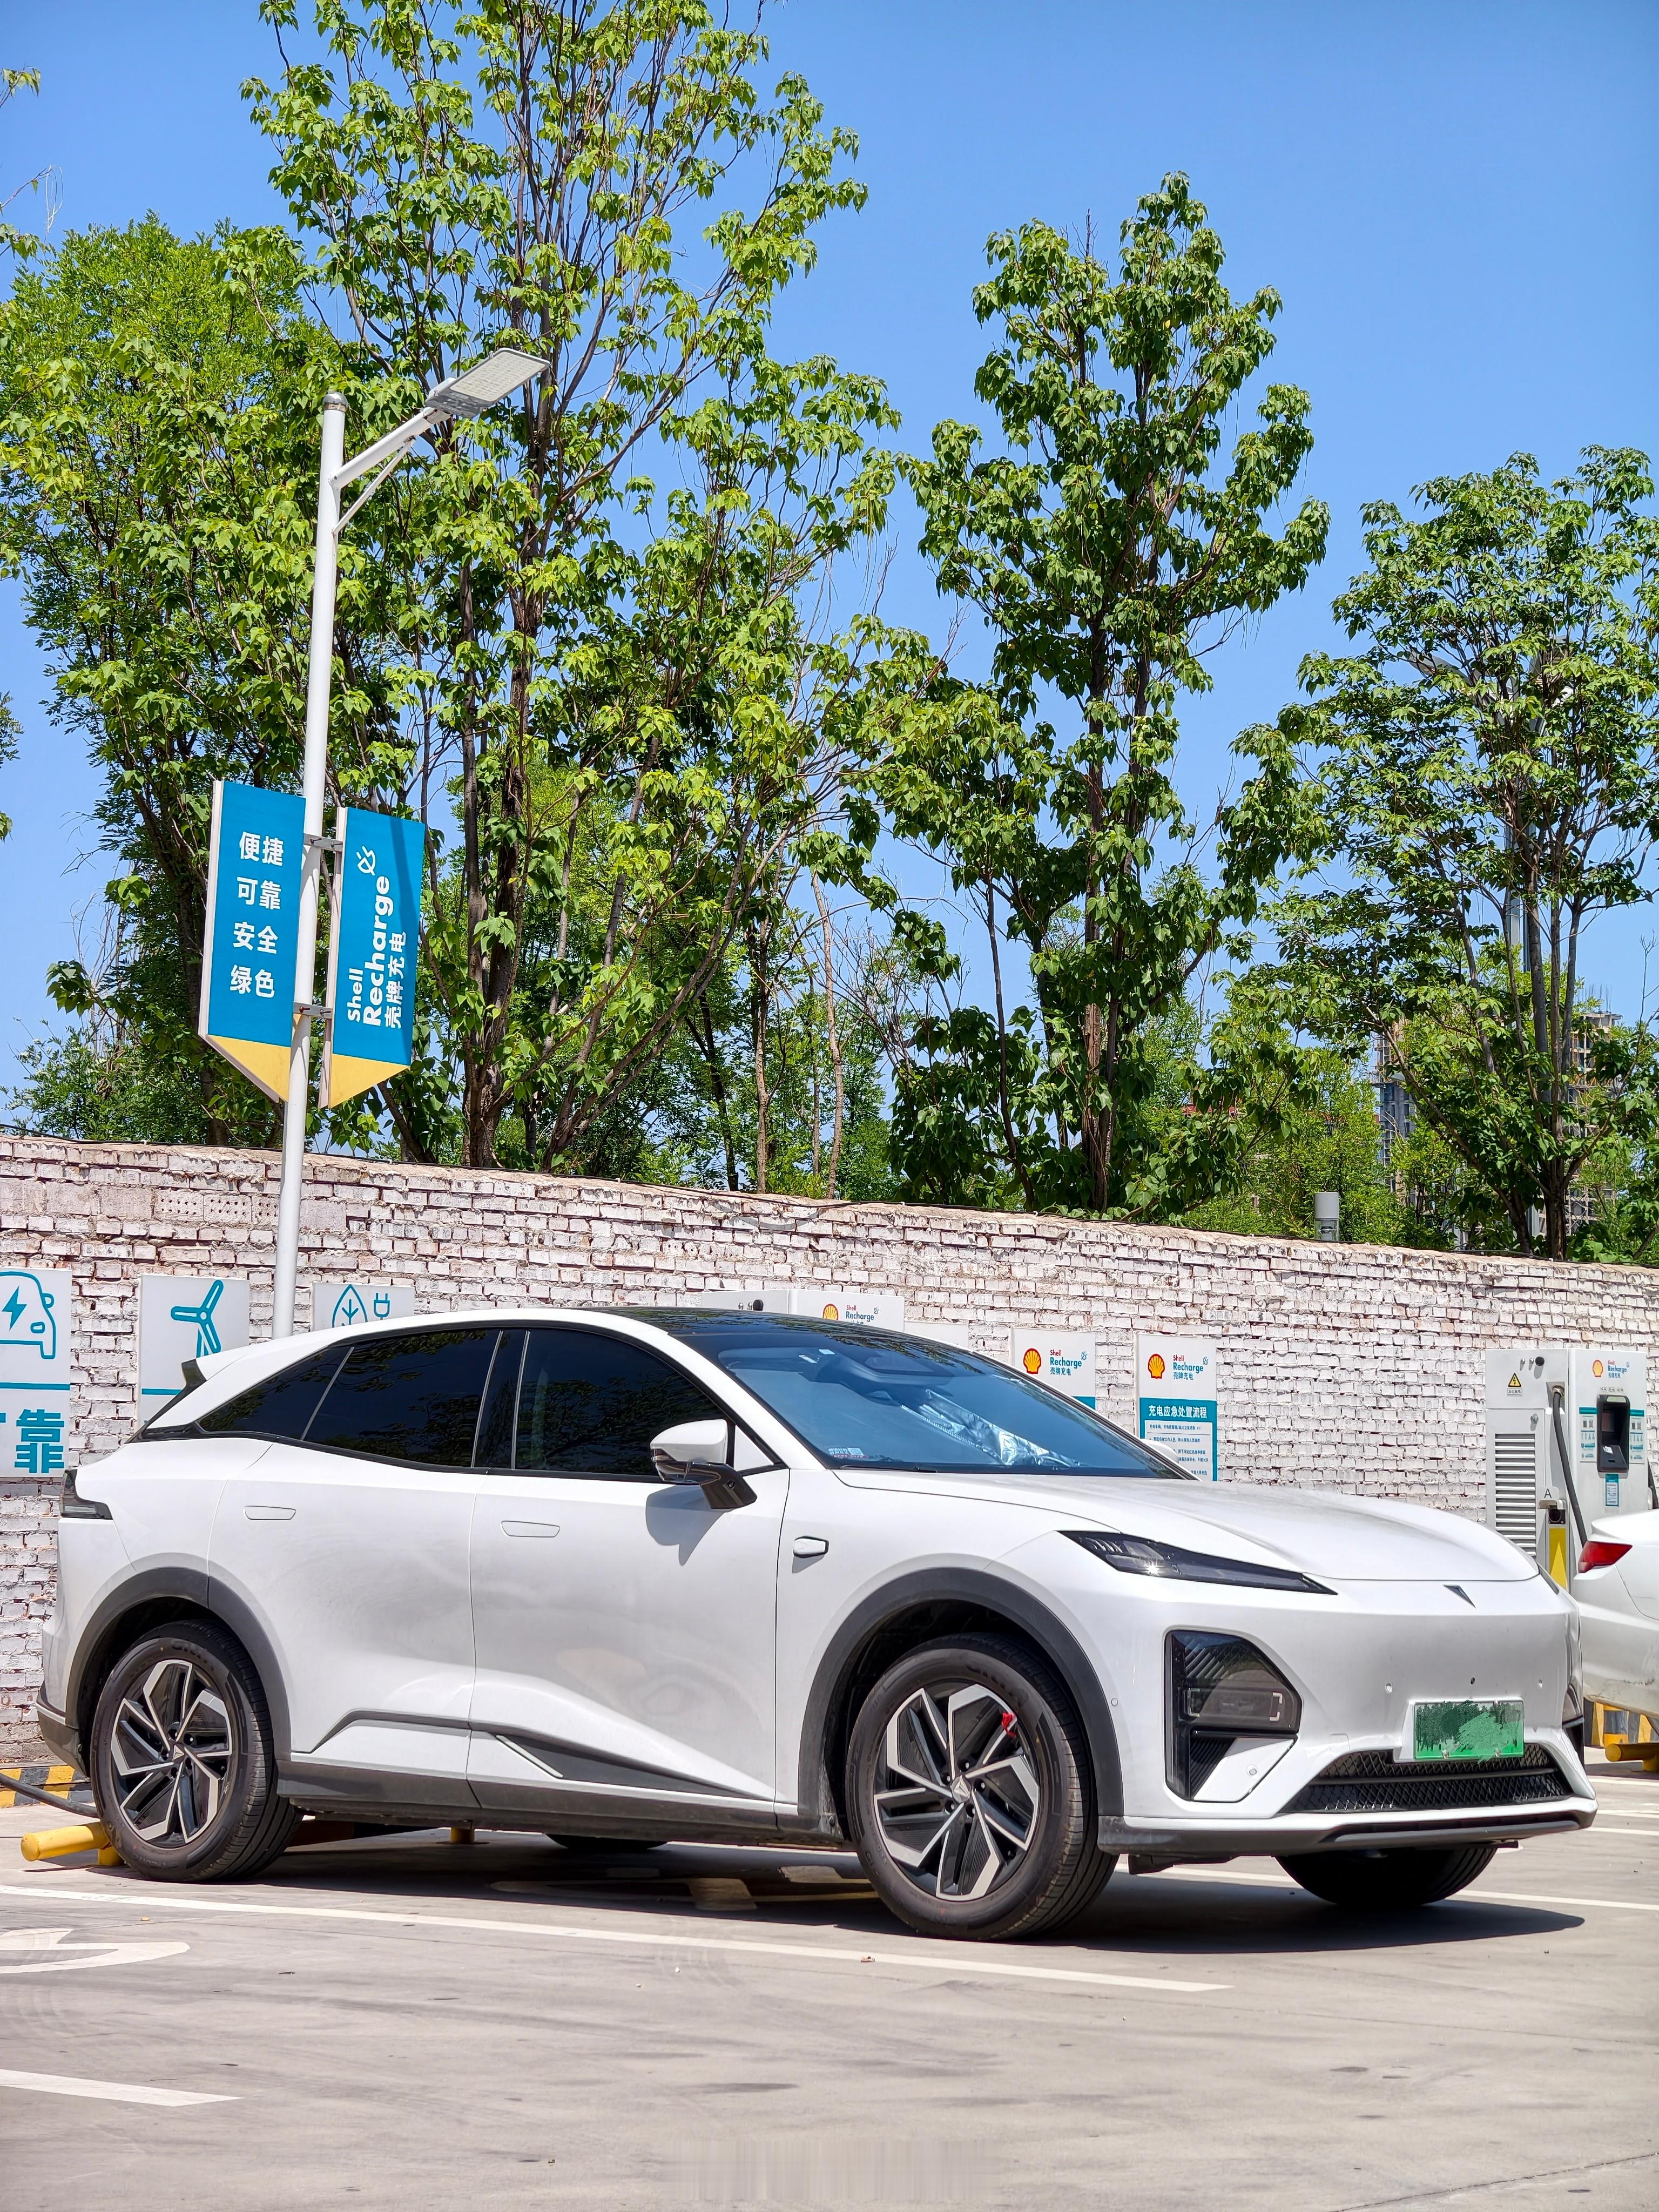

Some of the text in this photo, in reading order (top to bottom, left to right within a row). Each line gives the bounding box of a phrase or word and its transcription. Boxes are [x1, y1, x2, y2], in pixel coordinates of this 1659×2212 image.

[239, 831, 284, 866] 便捷
[237, 876, 281, 909] 可靠
[233, 921, 278, 954] 安全
[363, 875, 394, 1026] Recharge
[230, 965, 275, 998] 绿色
[347, 968, 363, 1022] Shell
[385, 932, 406, 1029] 壳牌充电
[846, 1311, 874, 1322] Recharge
[1050, 1357, 1082, 1369] Recharge
[1173, 1362, 1204, 1374] Recharge
[1608, 1365, 1627, 1373] Recharge
[1149, 1405, 1208, 1419] 充电应急处置流程
[0, 1408, 65, 1474] 靠
[1545, 1488, 1552, 1499] A
